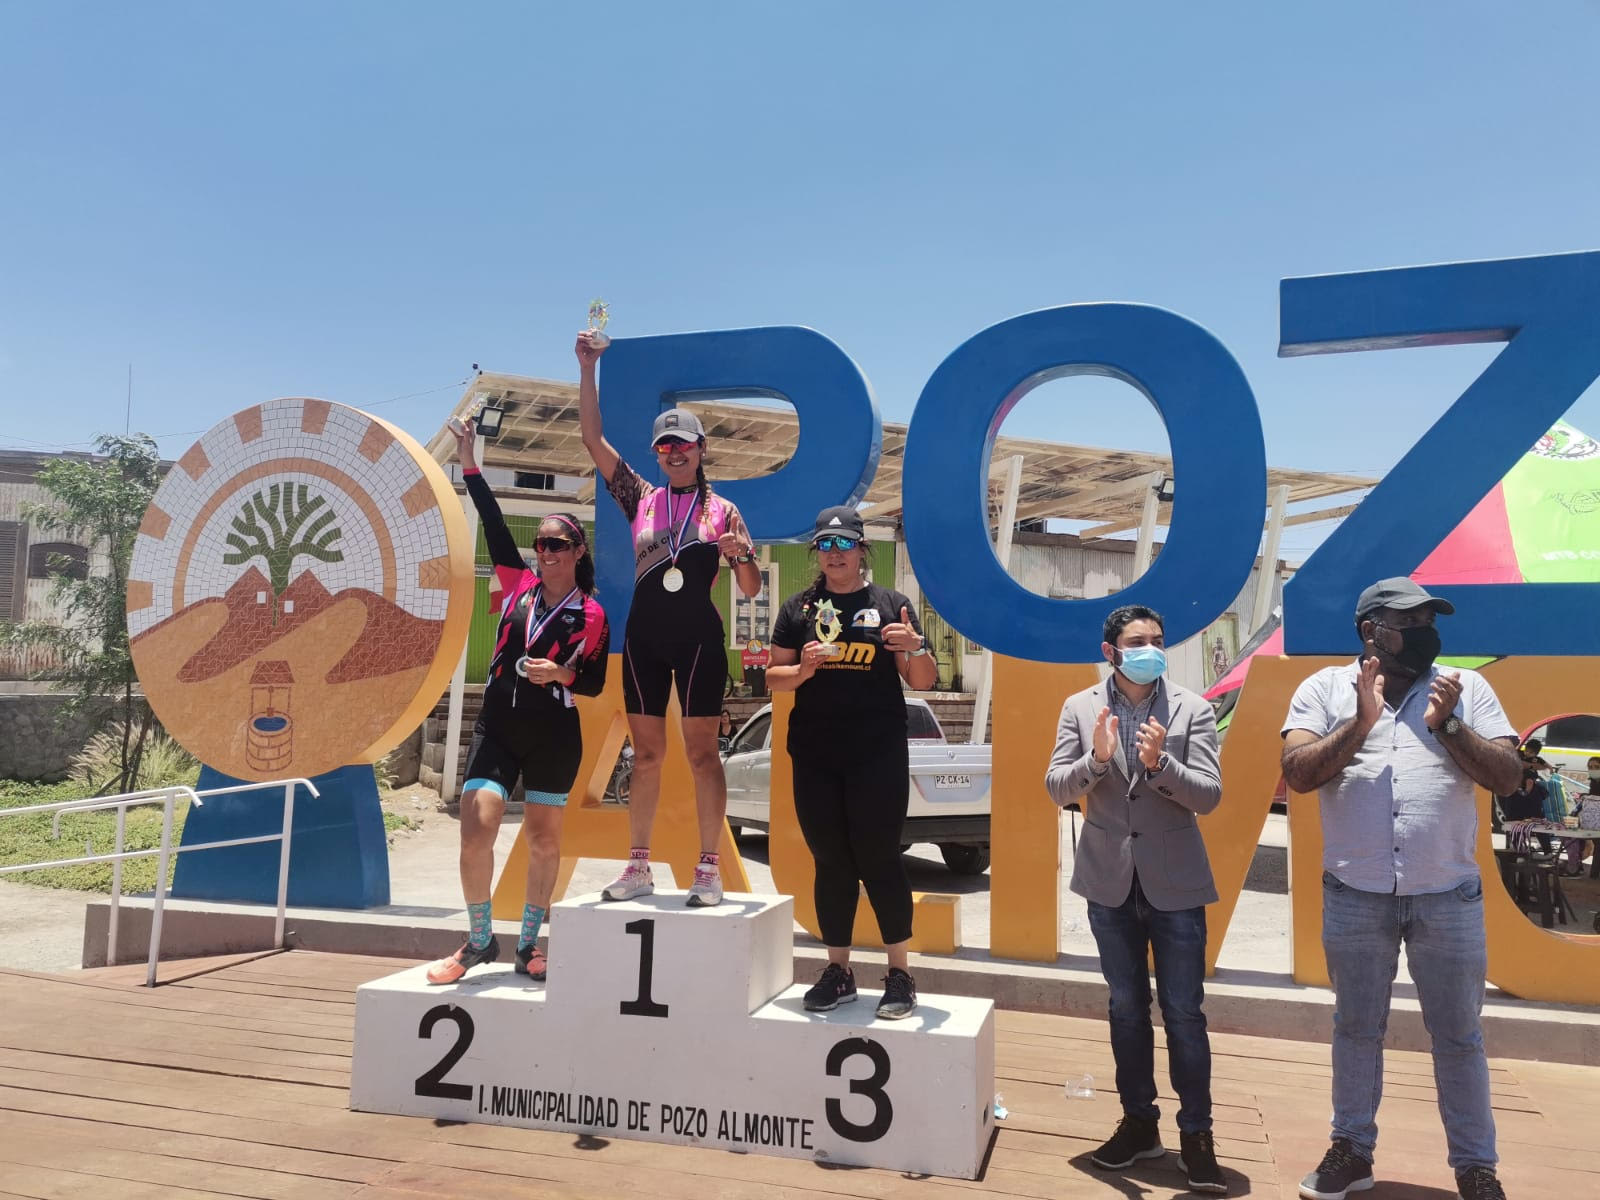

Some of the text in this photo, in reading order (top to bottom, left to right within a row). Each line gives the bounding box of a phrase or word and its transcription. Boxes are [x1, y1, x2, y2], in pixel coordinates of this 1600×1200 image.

[647, 541, 660, 553] DE
[619, 918, 669, 1019] 1
[414, 1003, 475, 1101] 2
[825, 1037, 894, 1143] 3
[491, 1085, 619, 1128] MUNICIPALIDAD
[627, 1099, 651, 1132] DE
[660, 1103, 708, 1138] POZO
[717, 1110, 814, 1151] ALMONTE
